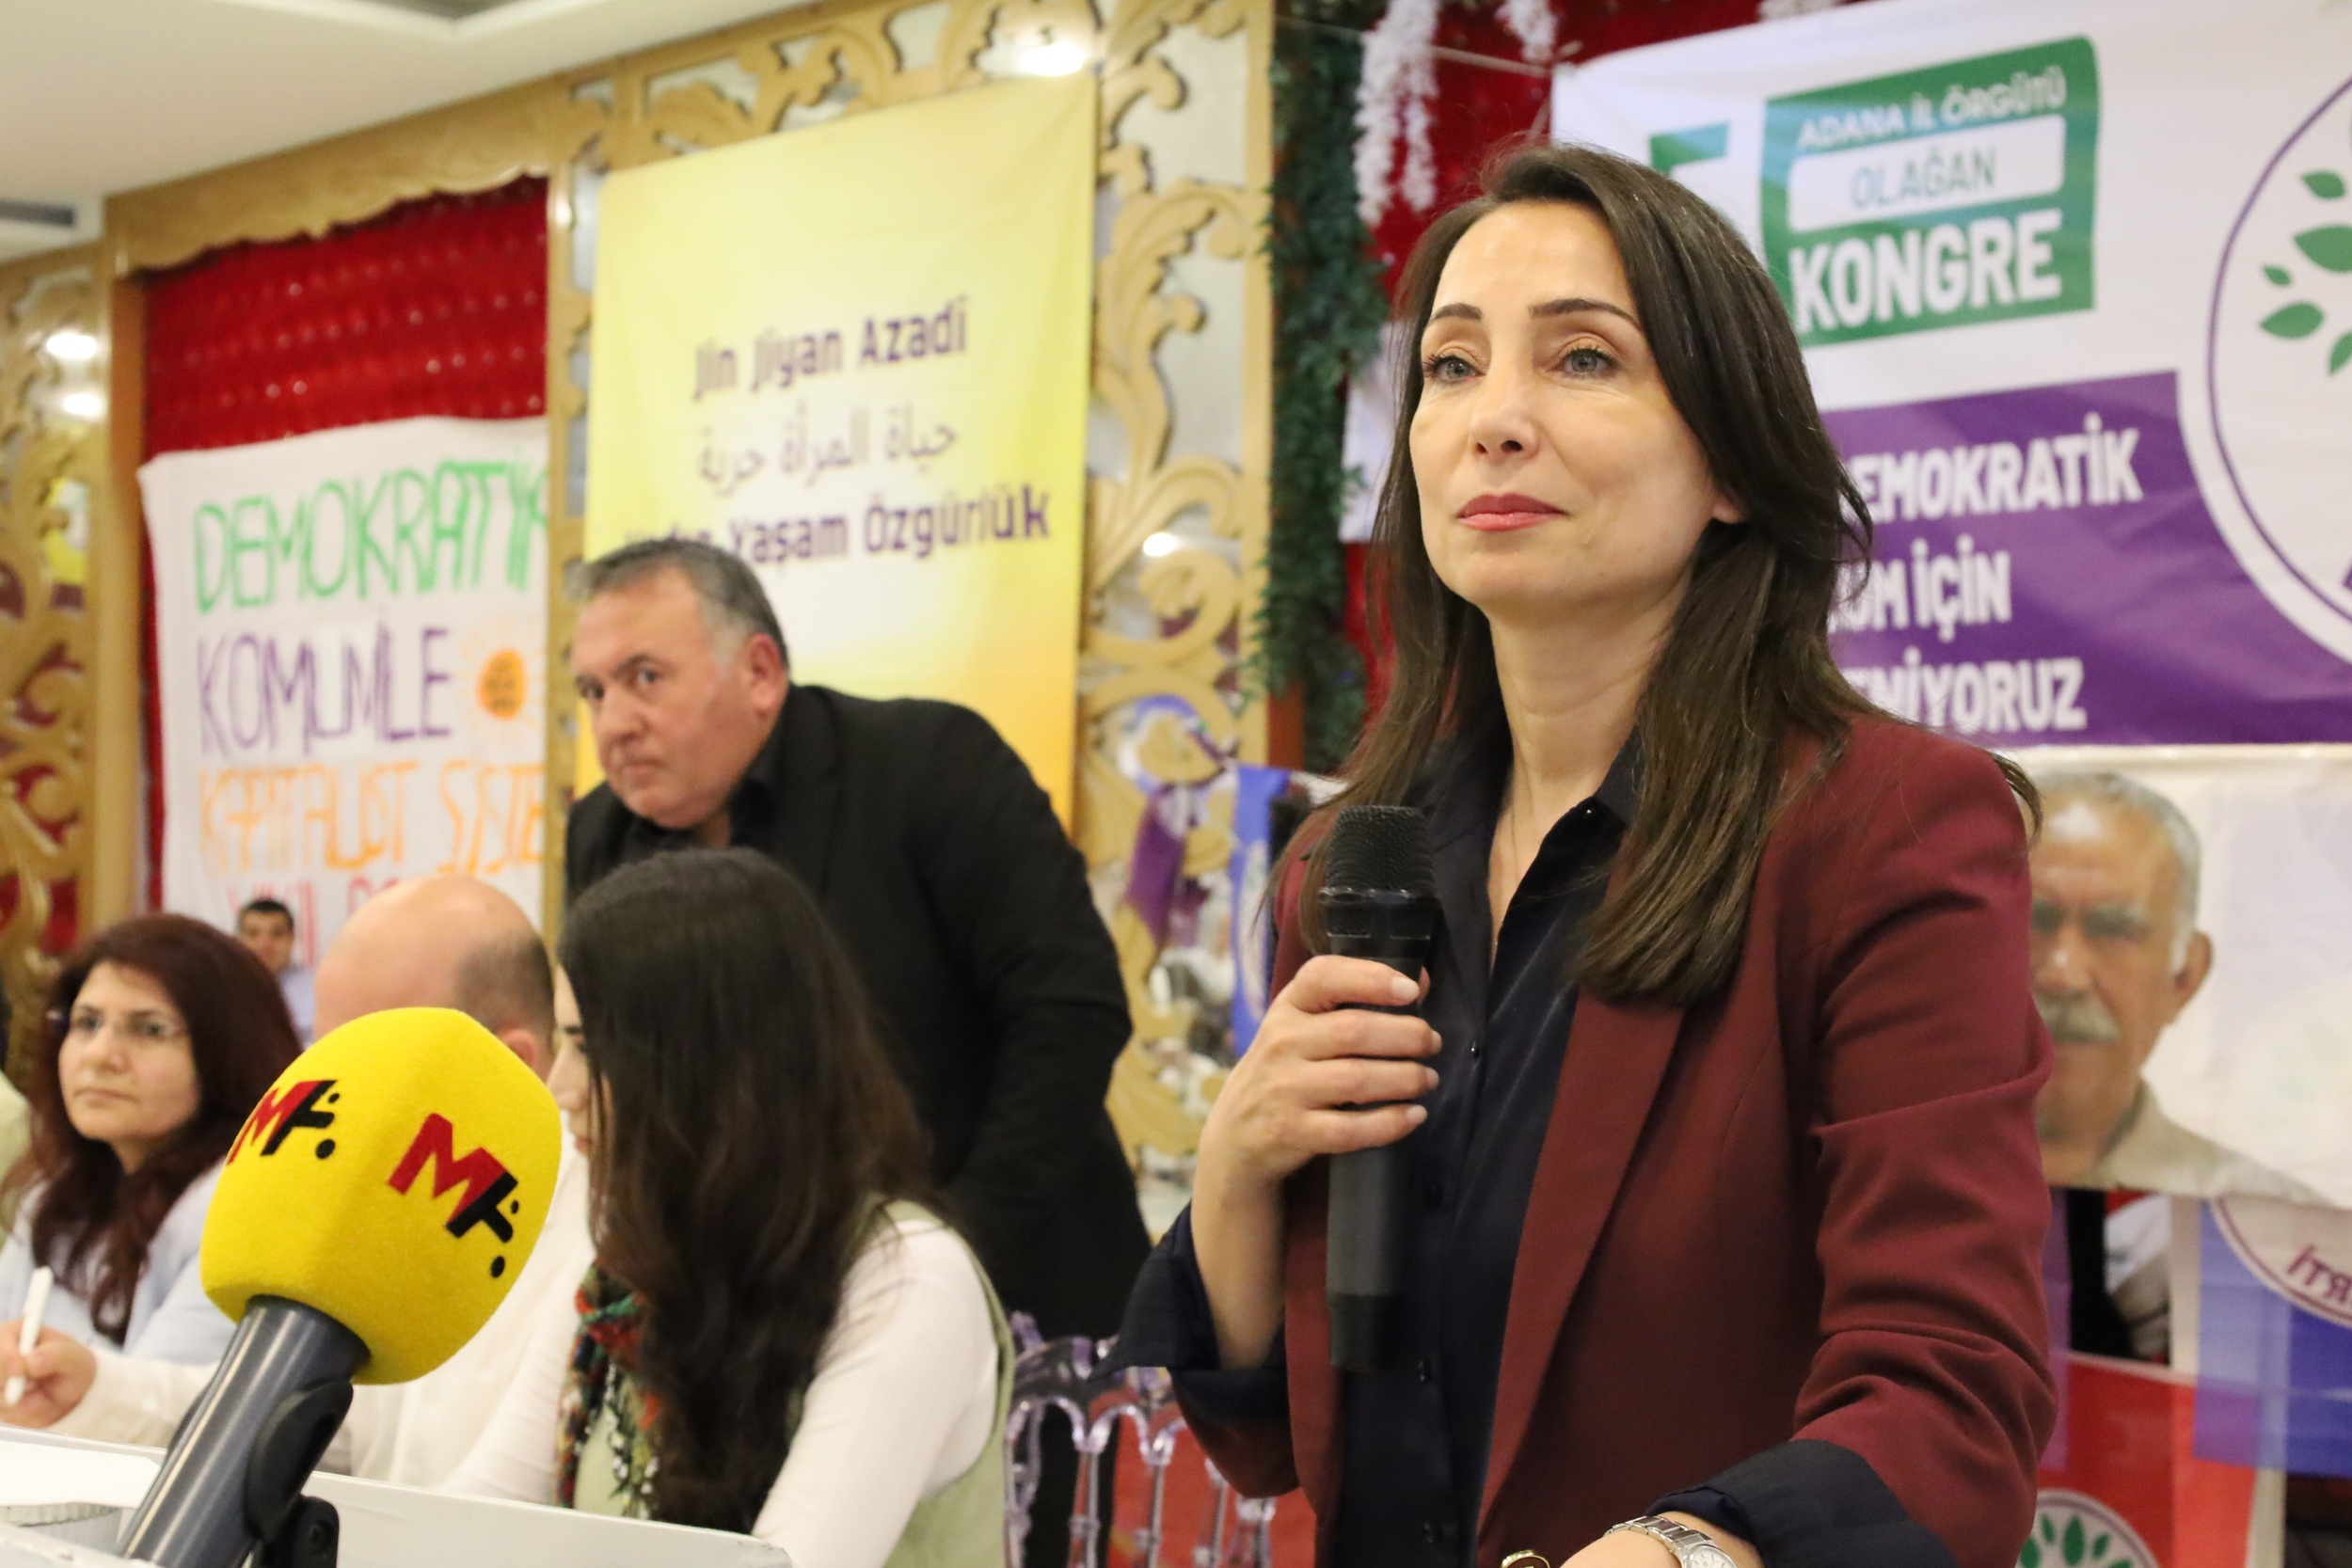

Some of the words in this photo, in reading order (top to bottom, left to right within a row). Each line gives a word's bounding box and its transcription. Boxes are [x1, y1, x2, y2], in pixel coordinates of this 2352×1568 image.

[1796, 103, 1906, 149] ADANA
[1910, 91, 1938, 131] İL
[1939, 64, 2067, 126] ÖRGÜTÜ
[1851, 146, 1996, 210] OLAĞAN
[1789, 208, 2063, 334] KONGRE
[1838, 410, 2143, 525] EMOKRATİK
[865, 483, 1051, 560] Özgürlük
[1911, 532, 2011, 642] İÇİN
